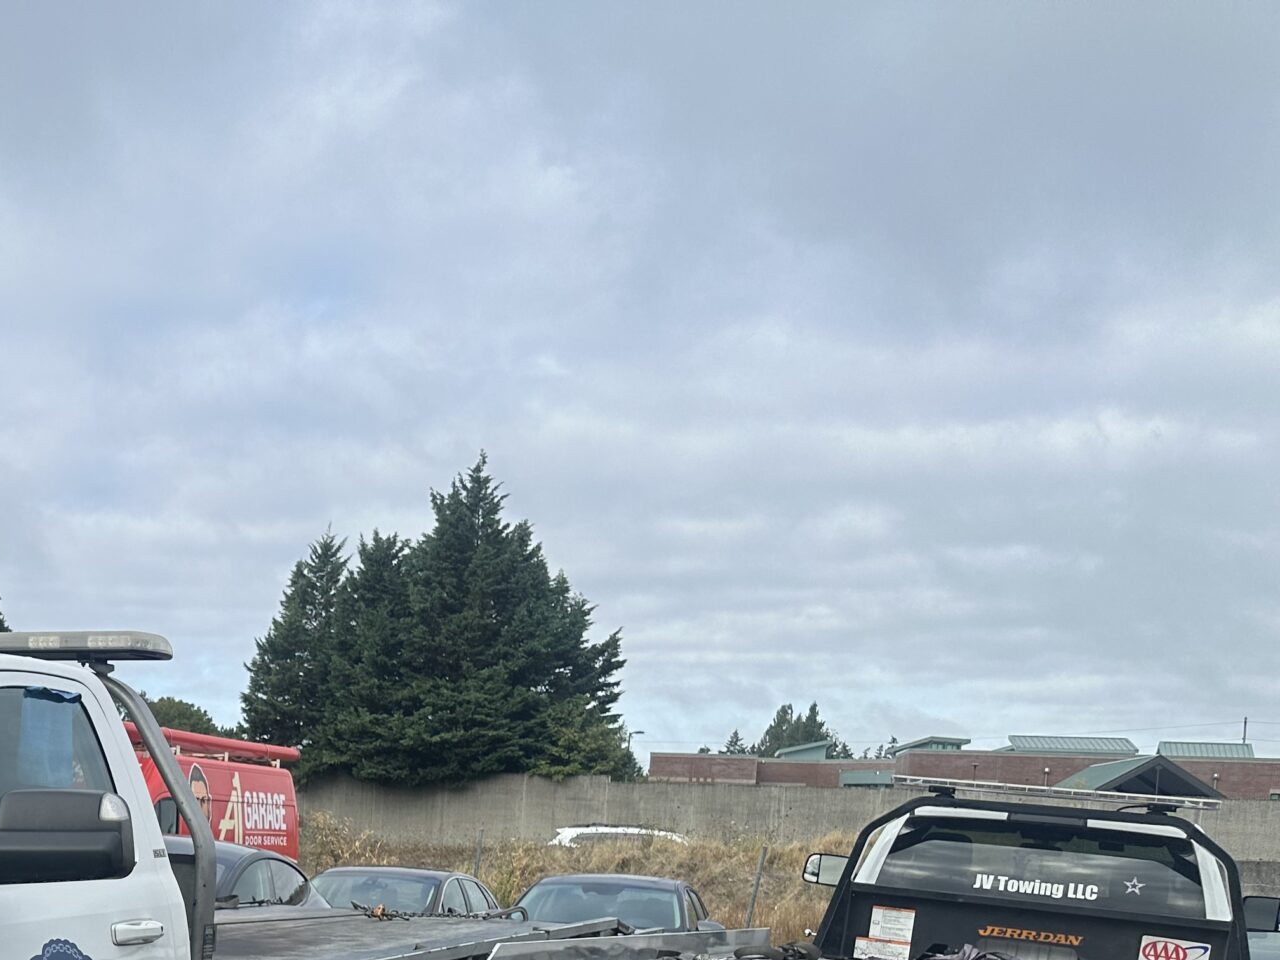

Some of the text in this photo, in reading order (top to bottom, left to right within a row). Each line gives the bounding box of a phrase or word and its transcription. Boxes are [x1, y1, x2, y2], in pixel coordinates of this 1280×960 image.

[244, 790, 287, 831] GARAGE
[245, 836, 287, 846] DOOR SERVICE
[973, 873, 1099, 901] JV Towing LLC
